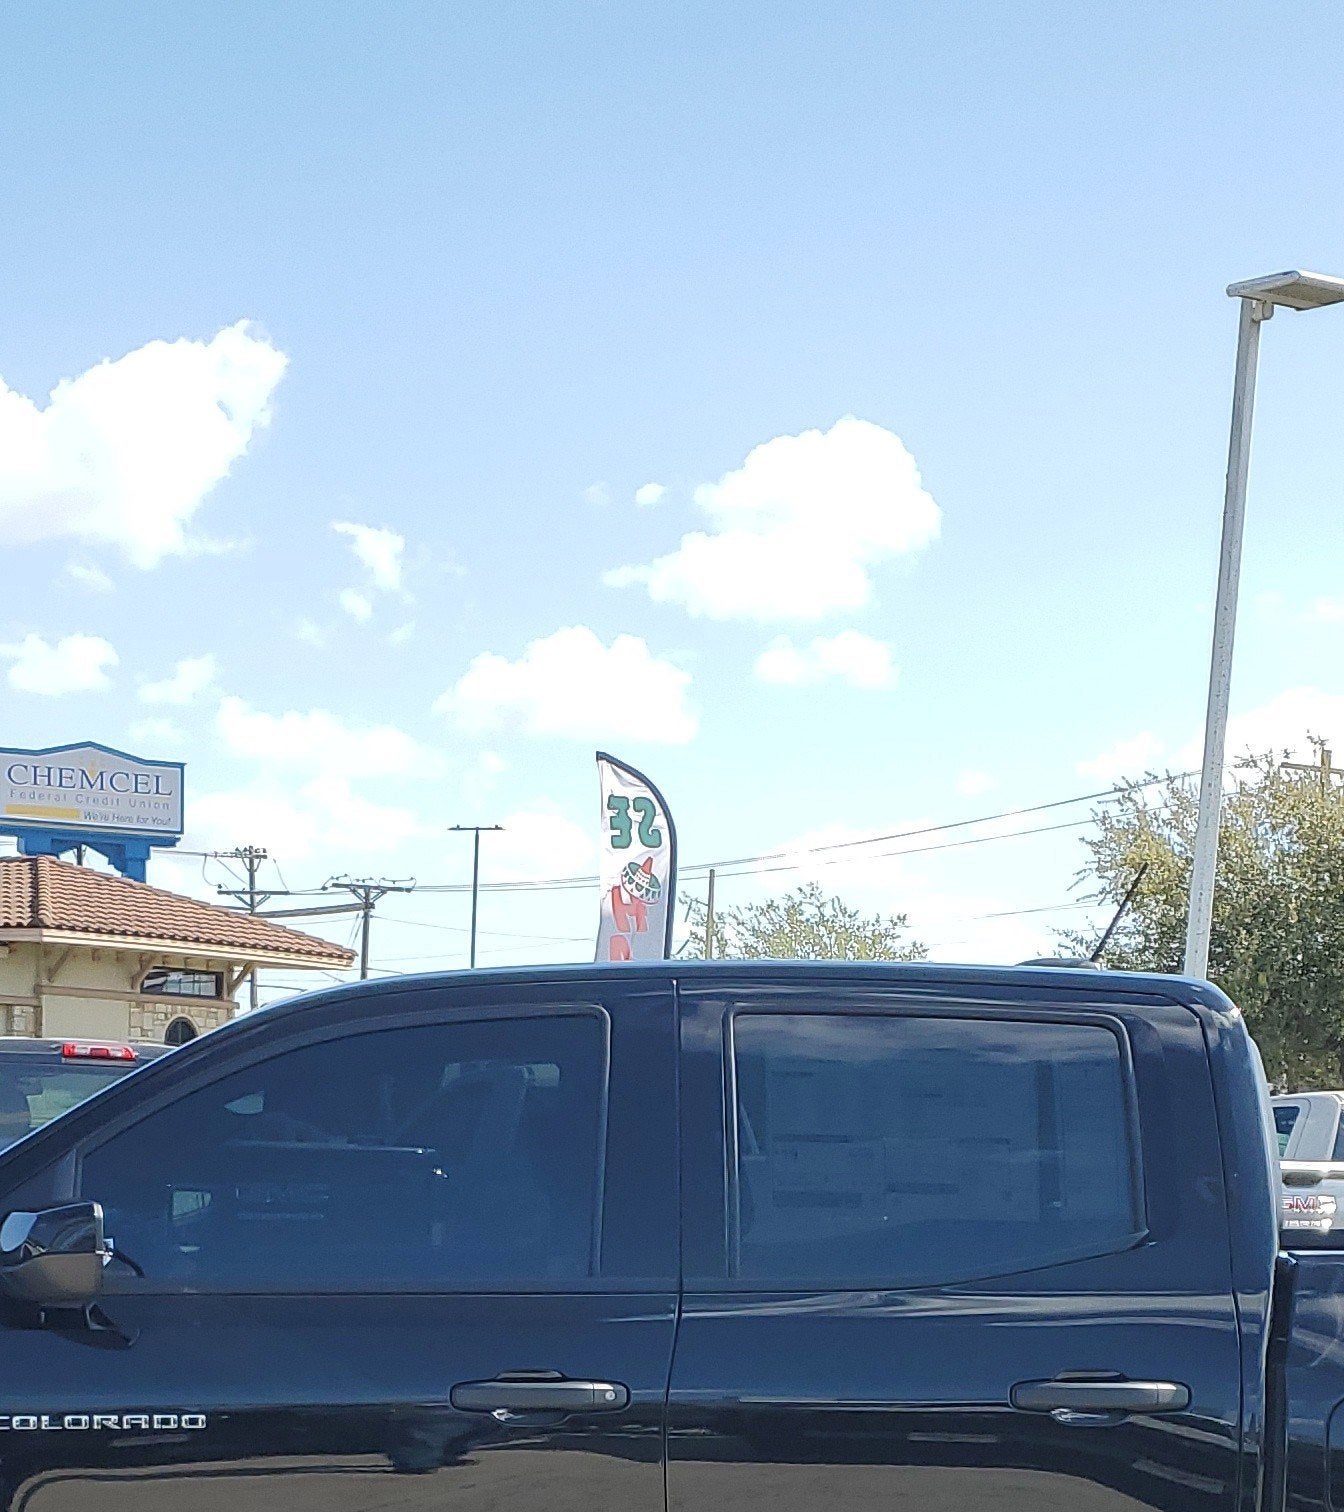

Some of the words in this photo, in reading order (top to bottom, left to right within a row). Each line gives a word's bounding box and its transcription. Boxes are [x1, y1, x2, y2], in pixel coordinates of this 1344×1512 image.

[7, 764, 173, 796] CHEMCEL
[9, 789, 67, 803] Federal
[75, 794, 120, 807] Credit
[128, 799, 170, 811] Union
